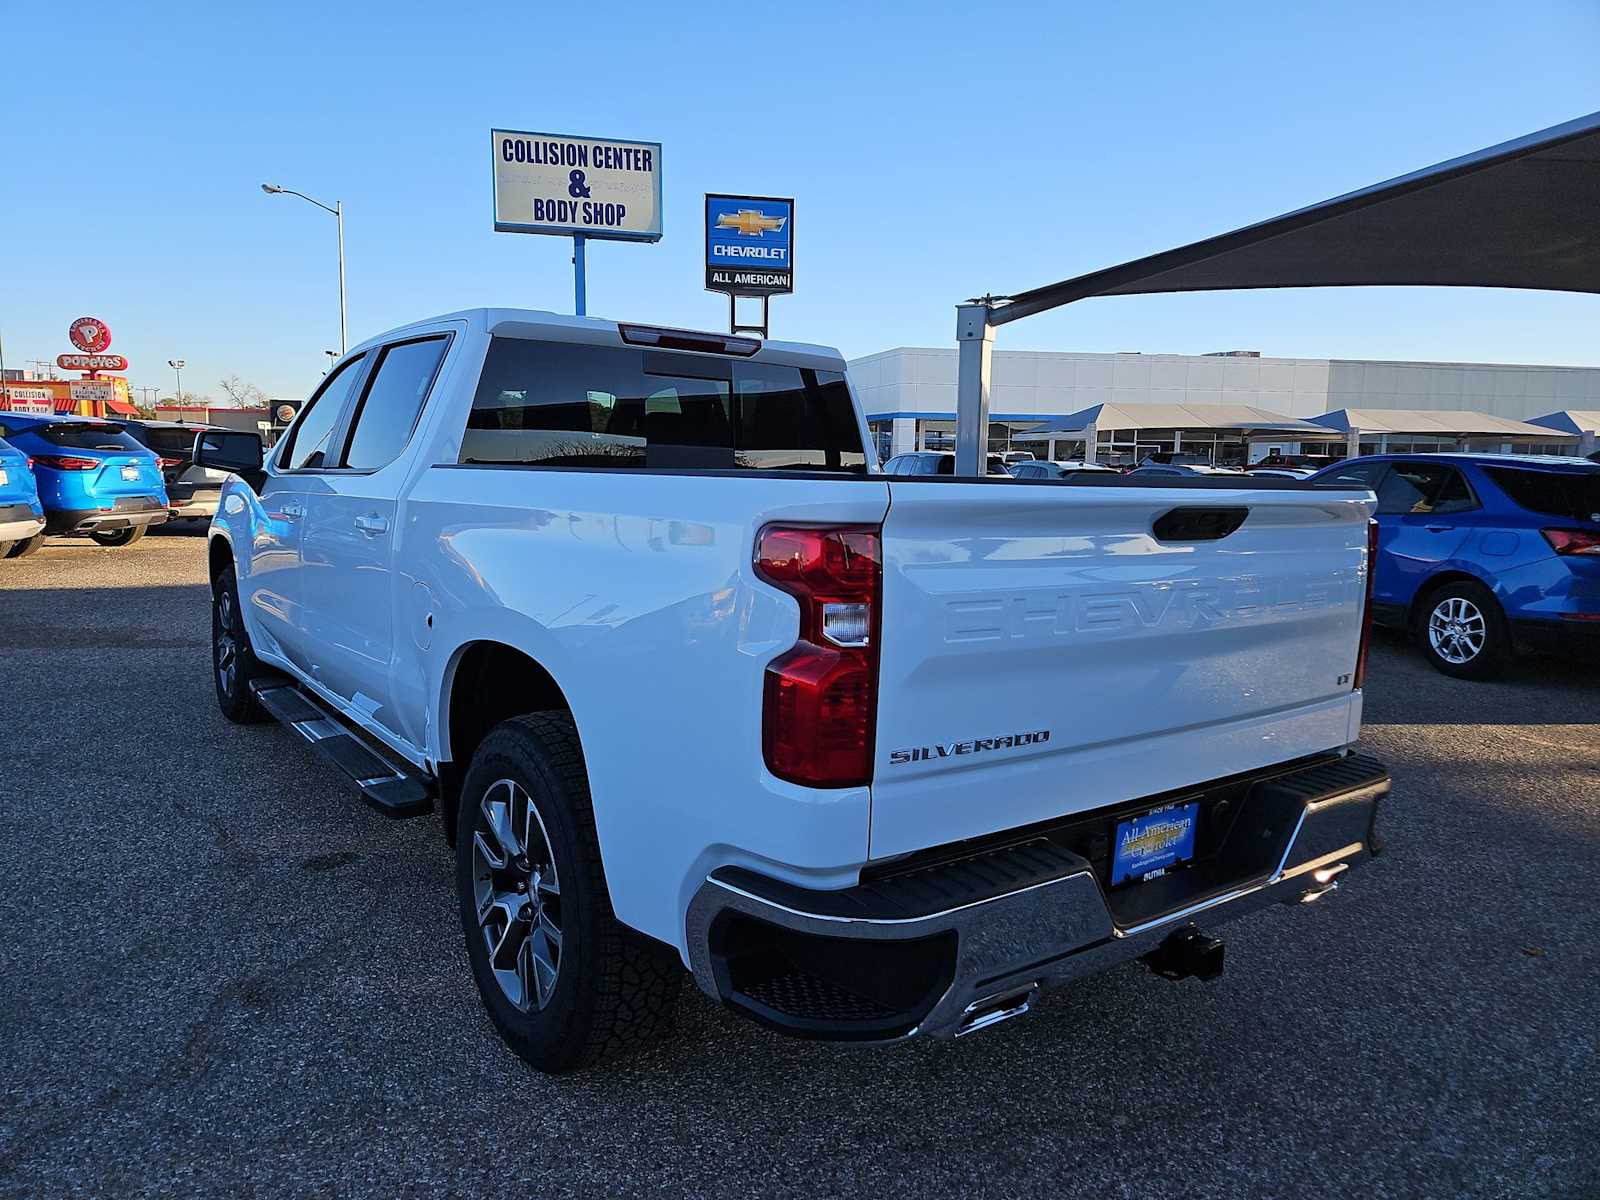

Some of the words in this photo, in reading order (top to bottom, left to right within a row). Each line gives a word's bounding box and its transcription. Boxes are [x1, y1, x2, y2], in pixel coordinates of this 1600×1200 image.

[502, 138, 588, 168] COLLISION
[592, 145, 652, 172] CENTER
[568, 169, 591, 198] &
[533, 198, 578, 223] BODY
[582, 201, 626, 226] SHOP
[713, 244, 787, 260] CHEVROLET
[712, 272, 731, 283] ALL
[734, 273, 787, 286] AMERICAN
[79, 325, 98, 344] P
[14, 390, 46, 399] COLLISION
[889, 730, 1051, 765] SILVERADO
